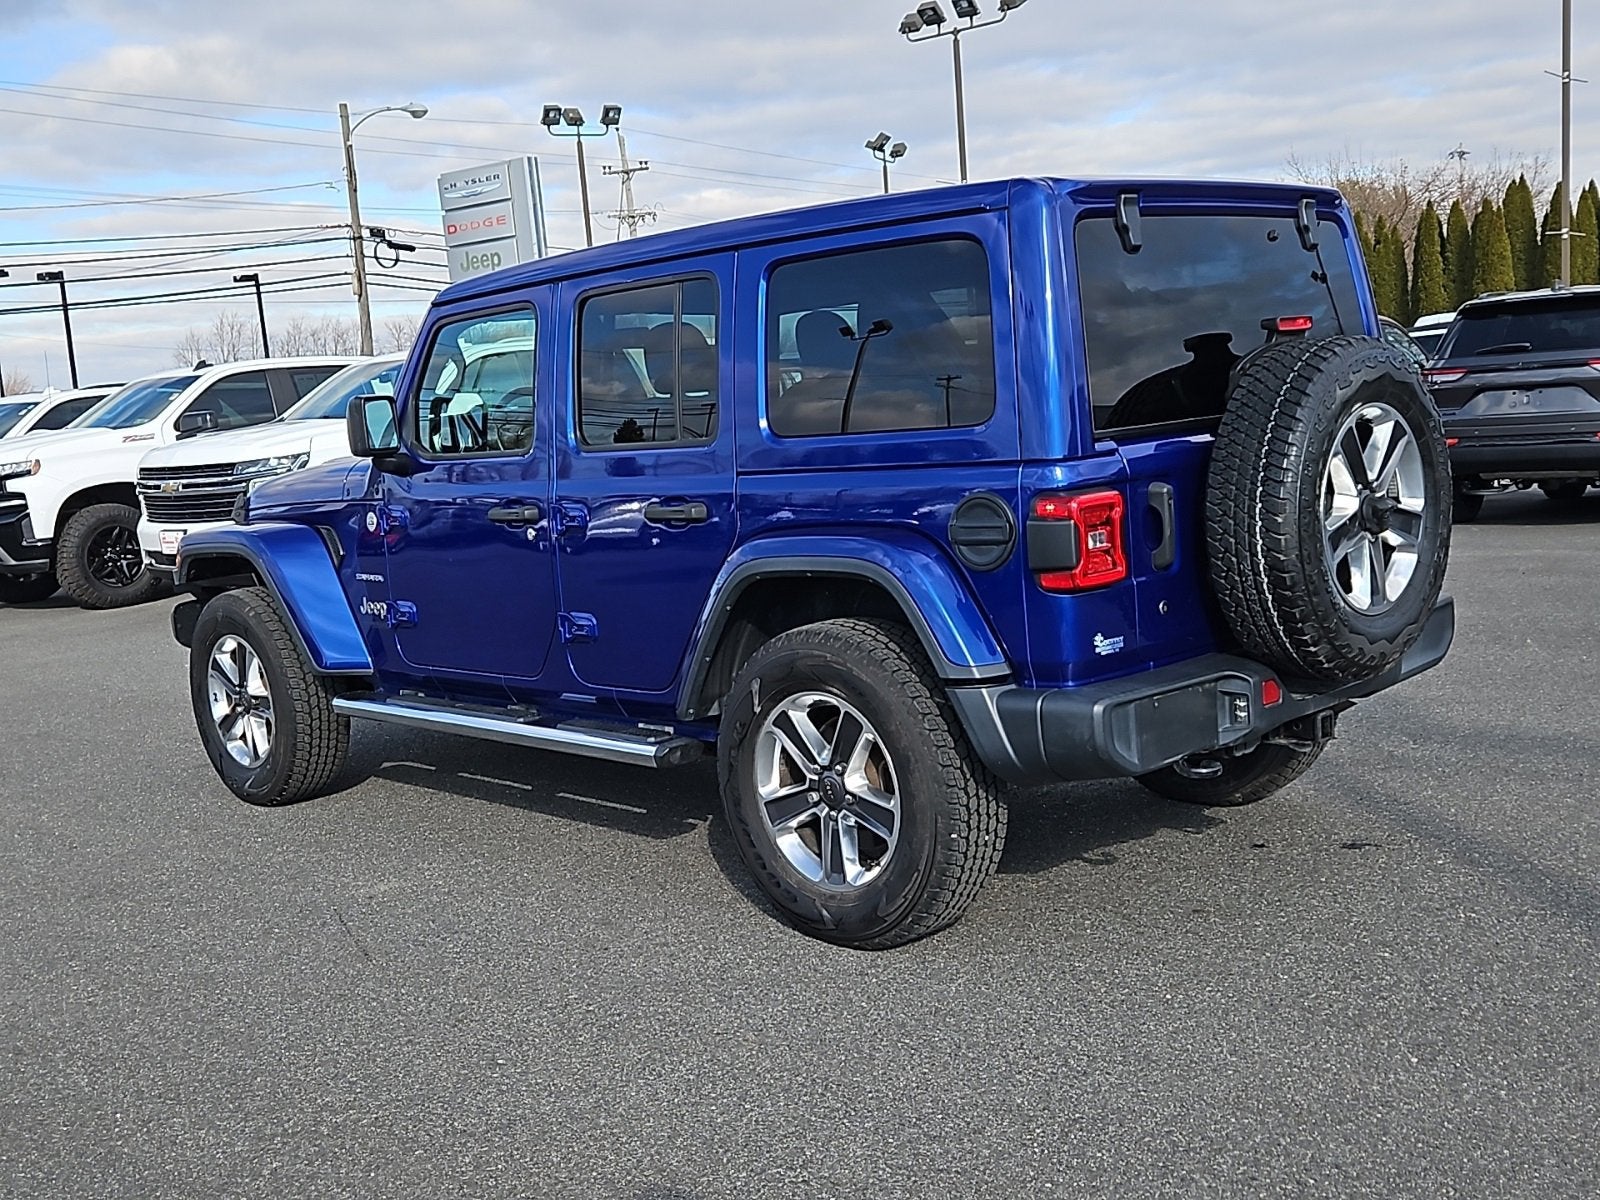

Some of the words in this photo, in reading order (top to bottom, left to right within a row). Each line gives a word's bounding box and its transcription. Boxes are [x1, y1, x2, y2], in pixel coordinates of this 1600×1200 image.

[444, 173, 500, 191] HYSLER
[447, 215, 507, 235] DODGE
[461, 251, 501, 272] Jeep
[360, 597, 387, 619] Jeep
